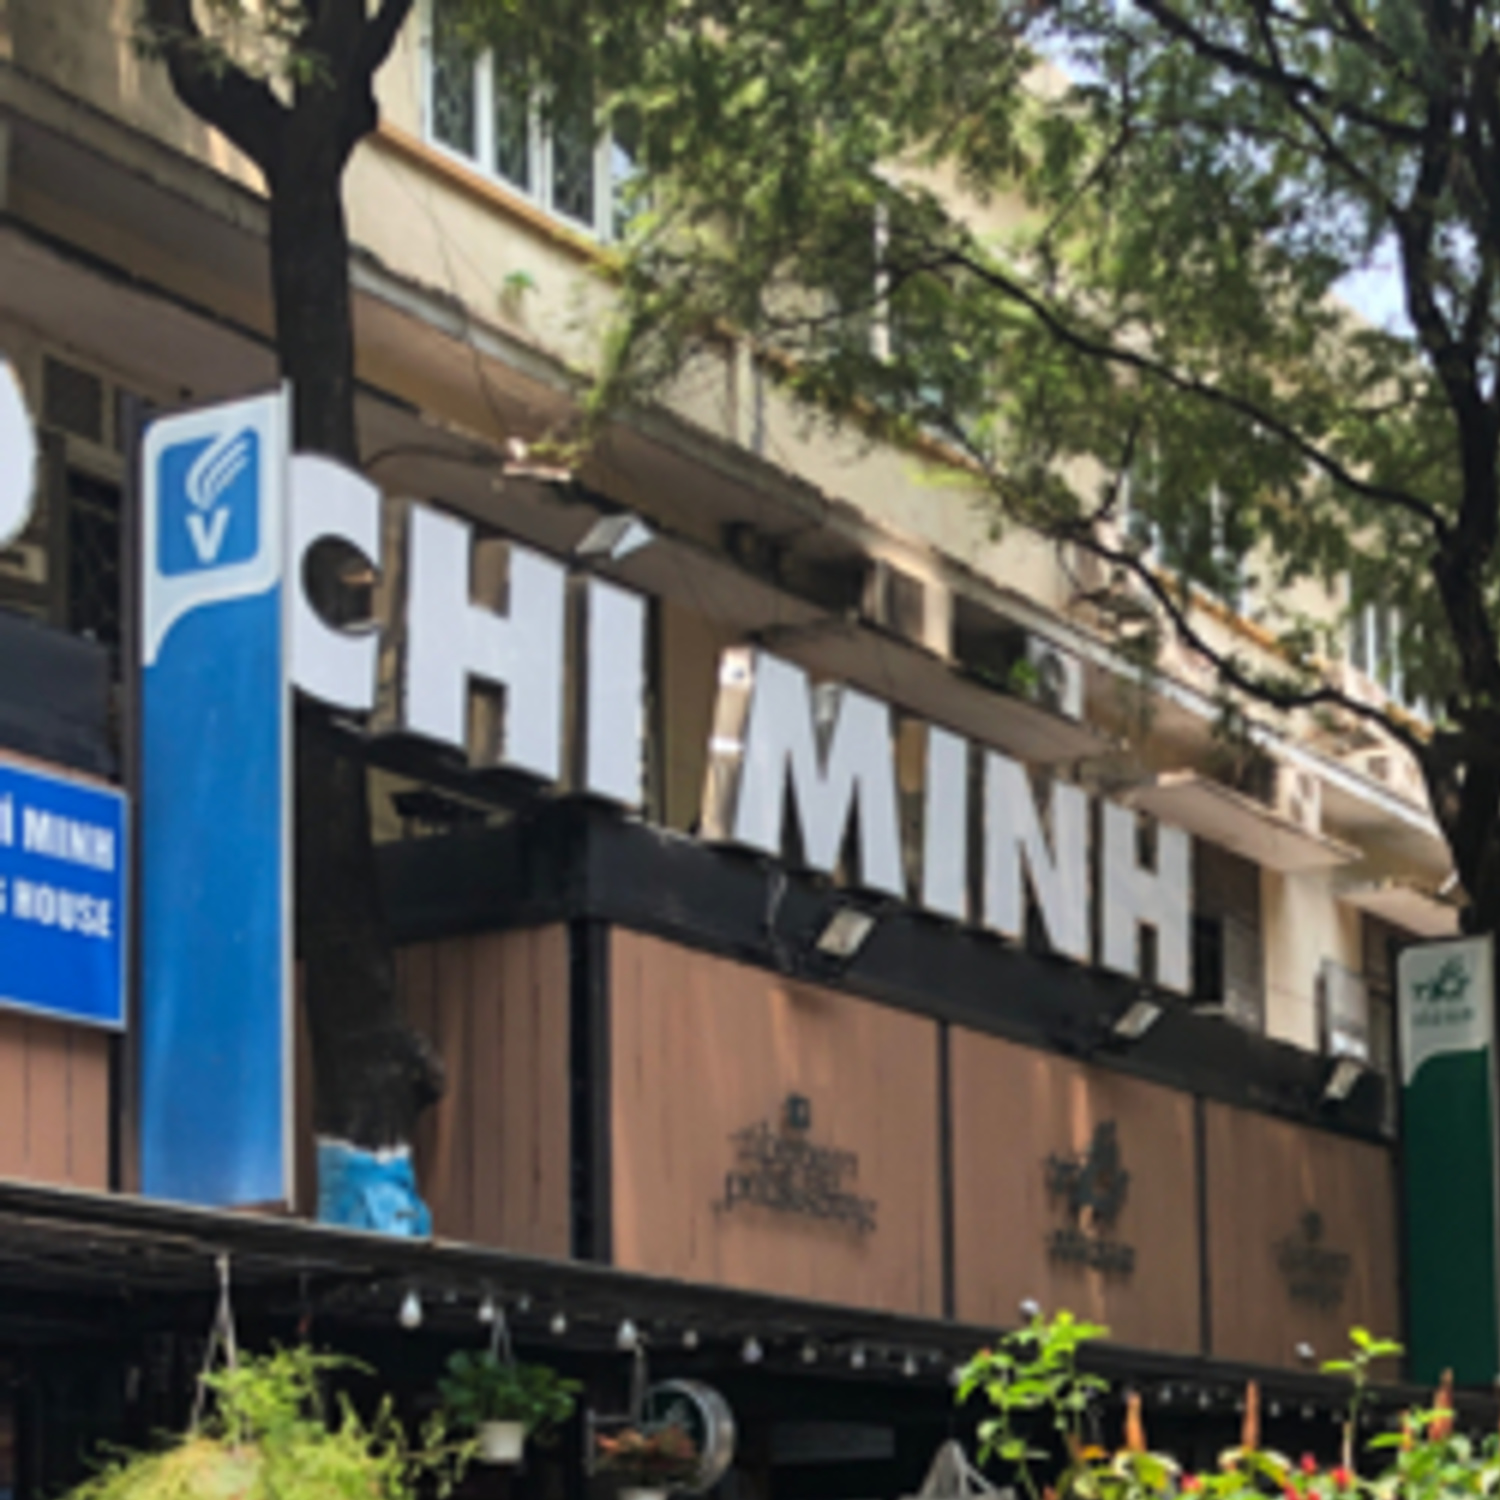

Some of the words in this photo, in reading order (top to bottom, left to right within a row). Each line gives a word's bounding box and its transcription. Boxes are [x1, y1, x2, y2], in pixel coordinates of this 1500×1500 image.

[291, 453, 646, 806] CHI
[731, 647, 1193, 997] MINH
[23, 806, 115, 871] MINH
[13, 879, 112, 938] HOUSE
